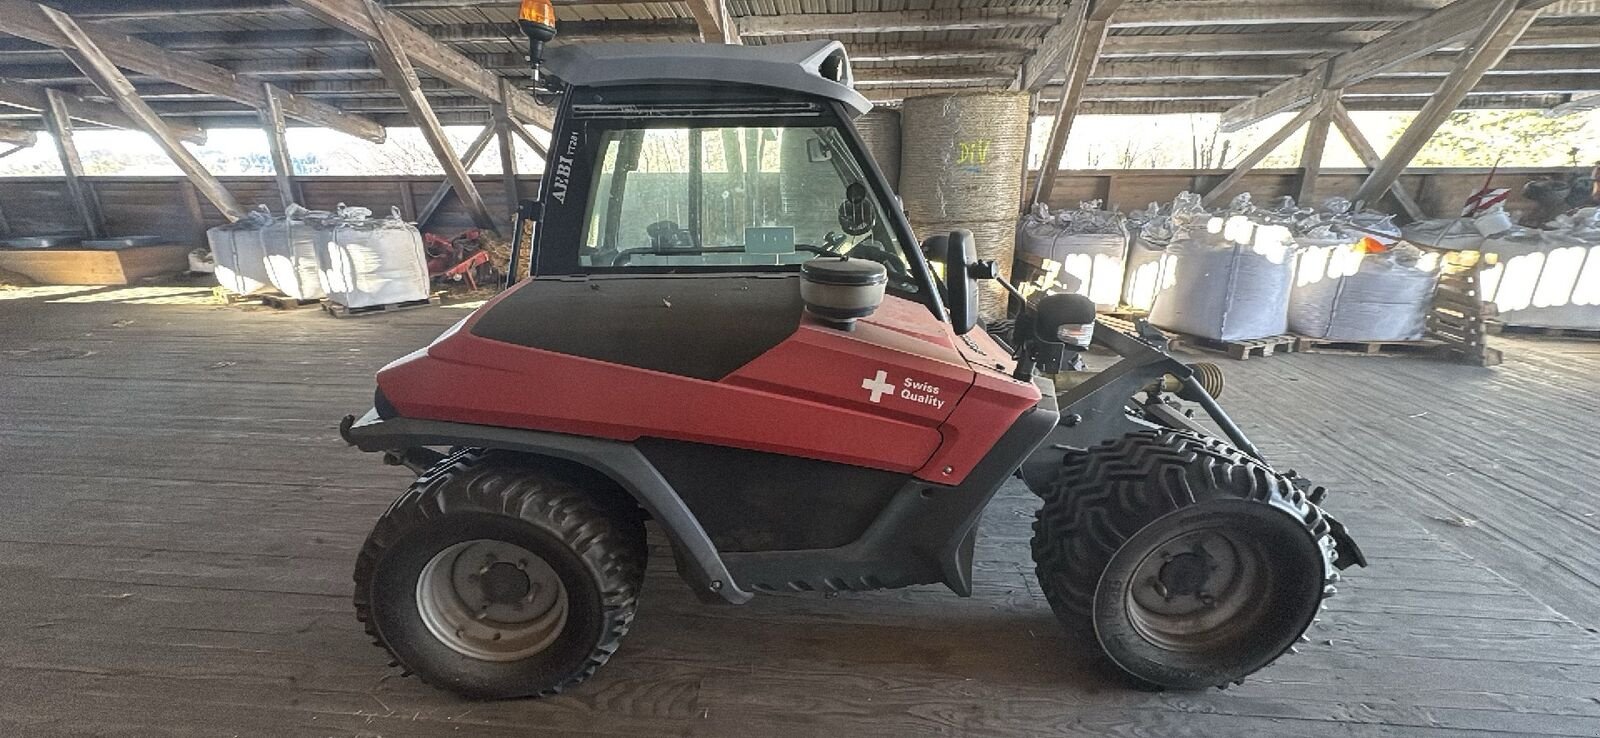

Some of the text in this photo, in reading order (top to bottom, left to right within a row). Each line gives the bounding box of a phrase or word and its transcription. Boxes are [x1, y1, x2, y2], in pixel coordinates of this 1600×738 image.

[552, 155, 574, 205] AEBI
[904, 377, 940, 395] Swiss
[901, 388, 945, 410] Quality
